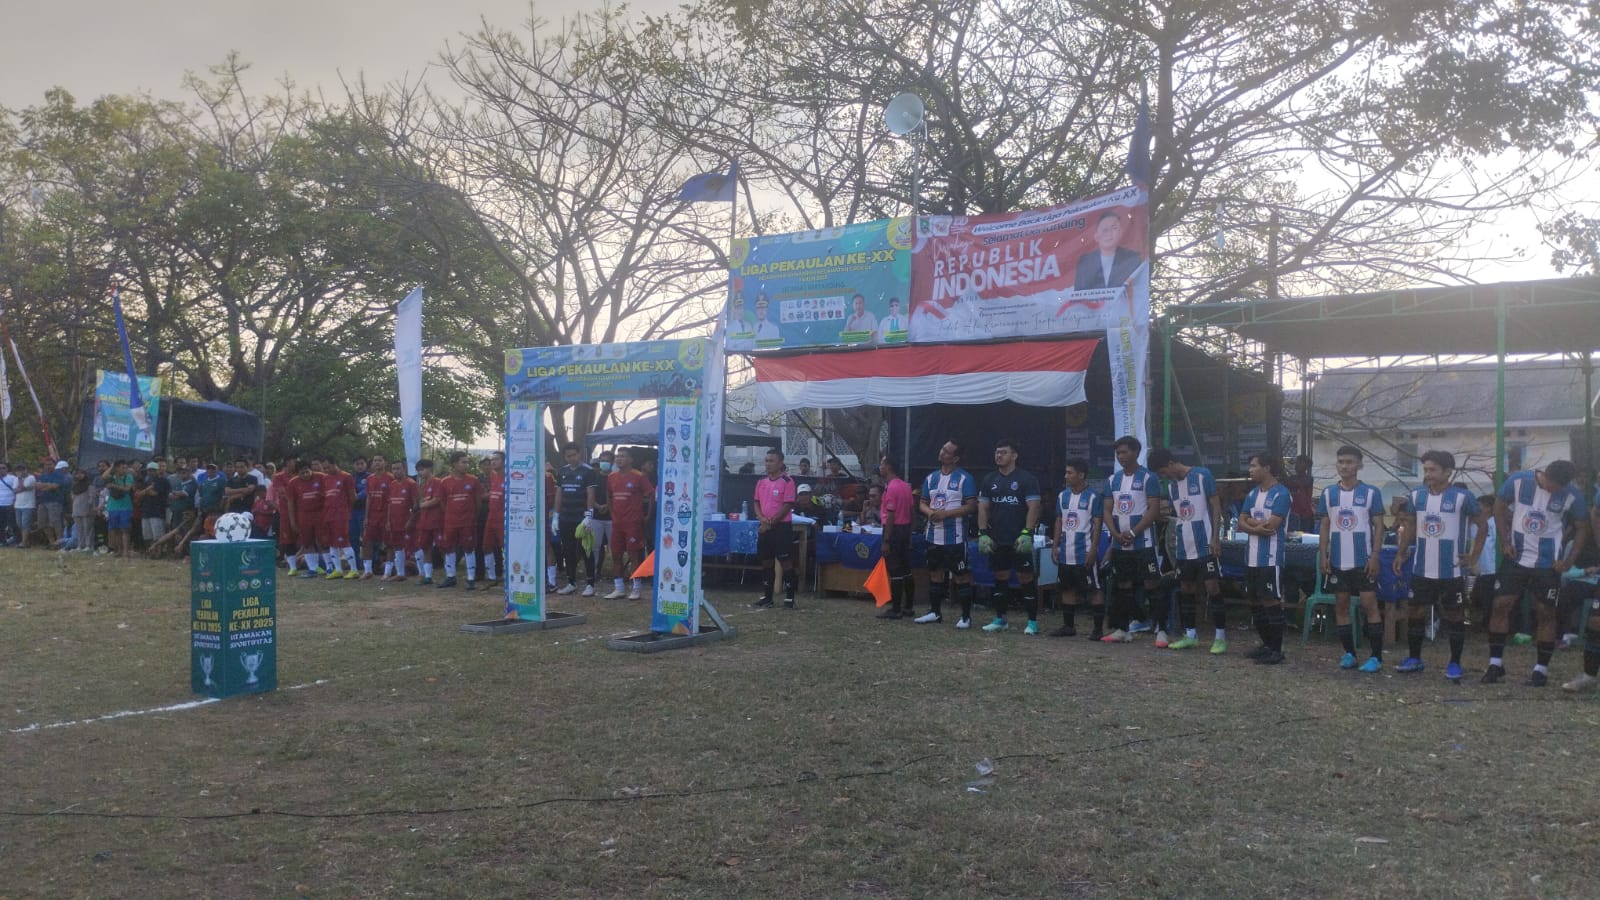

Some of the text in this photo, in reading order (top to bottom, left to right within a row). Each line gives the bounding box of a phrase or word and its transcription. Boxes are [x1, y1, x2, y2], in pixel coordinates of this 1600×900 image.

[740, 265, 769, 277] LIGA
[770, 255, 845, 273] PEKAULAN
[846, 249, 896, 266] KE-XX
[934, 239, 1043, 278] REPUBLIK
[932, 255, 1061, 301] INDONESIA
[527, 359, 676, 378] LIGA PEKAULAN KE-XX
[1206, 561, 1215, 572] 15
[1264, 582, 1273, 592] 4
[242, 597, 260, 607] LIGA
[1456, 592, 1463, 604] 3
[232, 607, 270, 620] PEKAULAN
[228, 617, 274, 632] KE-XX 2025
[230, 630, 272, 641] UTAMAKAN
